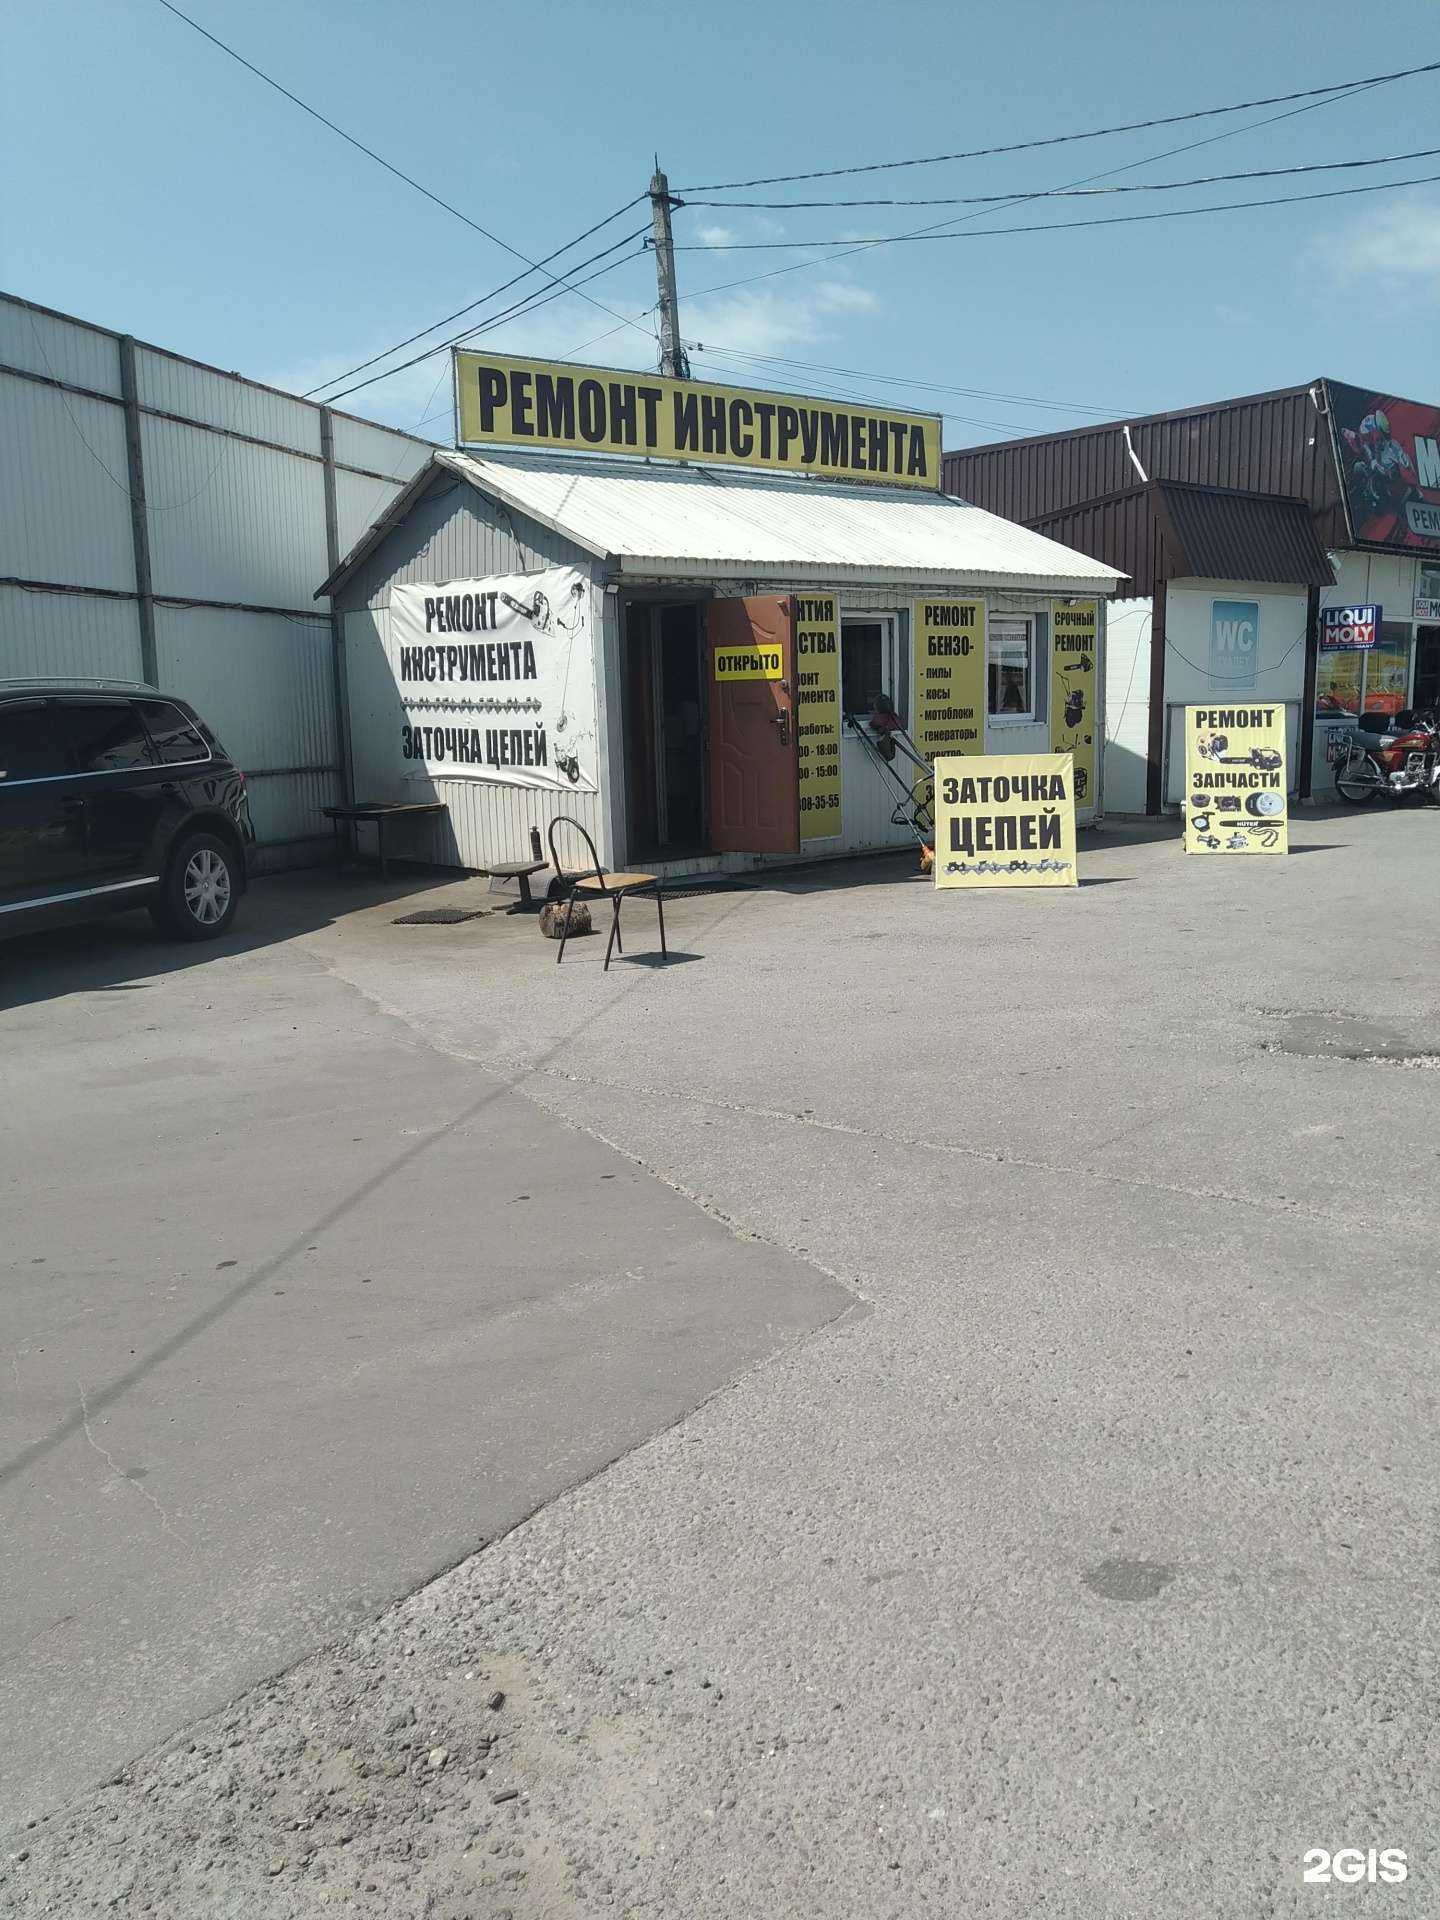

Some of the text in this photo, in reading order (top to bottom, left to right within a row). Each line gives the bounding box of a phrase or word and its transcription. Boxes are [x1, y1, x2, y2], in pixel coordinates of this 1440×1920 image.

[478, 366, 927, 477] РЕМОНТ ИНСТРУМЕНТА
[424, 591, 498, 632] РЕМОНТ
[924, 605, 976, 627] РЕМОНТ
[1055, 609, 1095, 626] СРОЧНЫЙ
[1326, 608, 1372, 626] LIQUI
[1216, 620, 1253, 652] WC
[1325, 625, 1373, 643] MOLY
[928, 635, 974, 656] БЕНЗО-
[1055, 635, 1095, 652] РЕМОНТ
[400, 641, 537, 682] ИНСТРУМЕНТА
[718, 654, 779, 672] ОТКРЫТО
[926, 666, 951, 679] пилы
[926, 688, 950, 700] косы
[924, 707, 973, 721] мотоблоки
[1196, 709, 1275, 728] РЕМОНТ
[925, 729, 977, 742] генераторы
[402, 721, 547, 770] ЗАТОЧКА ЦЕПЕЙ
[816, 743, 838, 756] 18:00
[816, 764, 838, 777] 15:00
[943, 774, 1066, 804] ЗАТОЧКА
[1193, 772, 1280, 788] ЗАПЧАСТИ
[950, 807, 1061, 857] ЦЕПЕЙ
